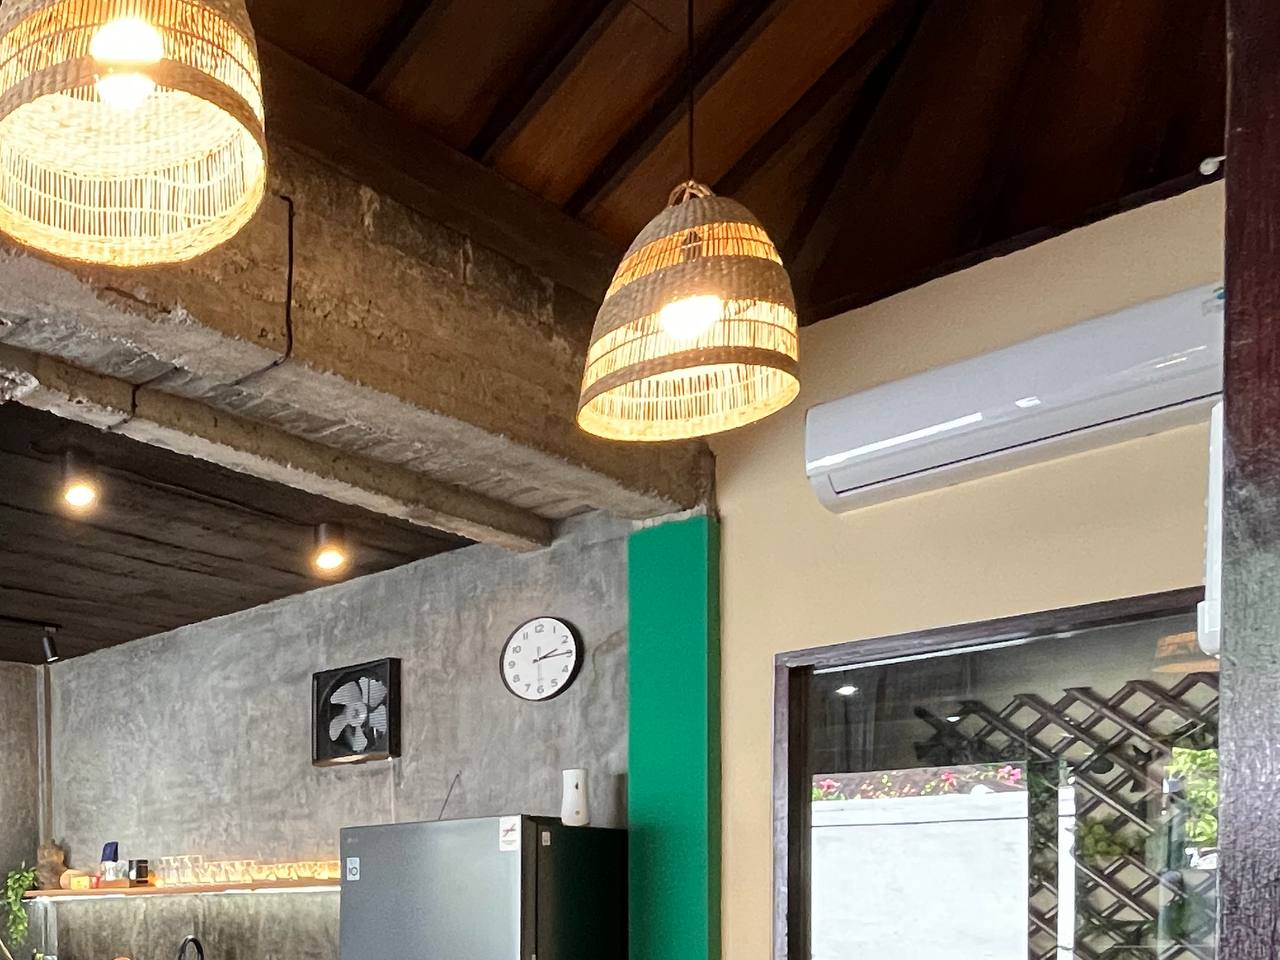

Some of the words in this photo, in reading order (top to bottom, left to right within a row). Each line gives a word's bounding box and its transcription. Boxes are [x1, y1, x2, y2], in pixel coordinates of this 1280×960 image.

[534, 624, 544, 633] 12
[523, 632, 528, 640] 11
[561, 635, 569, 644] 2
[512, 645, 522, 654] 10
[508, 661, 516, 669] 9
[562, 665, 569, 673] 4
[512, 674, 520, 683] 8
[550, 678, 558, 687] 5
[524, 683, 531, 692] 7
[536, 685, 544, 694] 6
